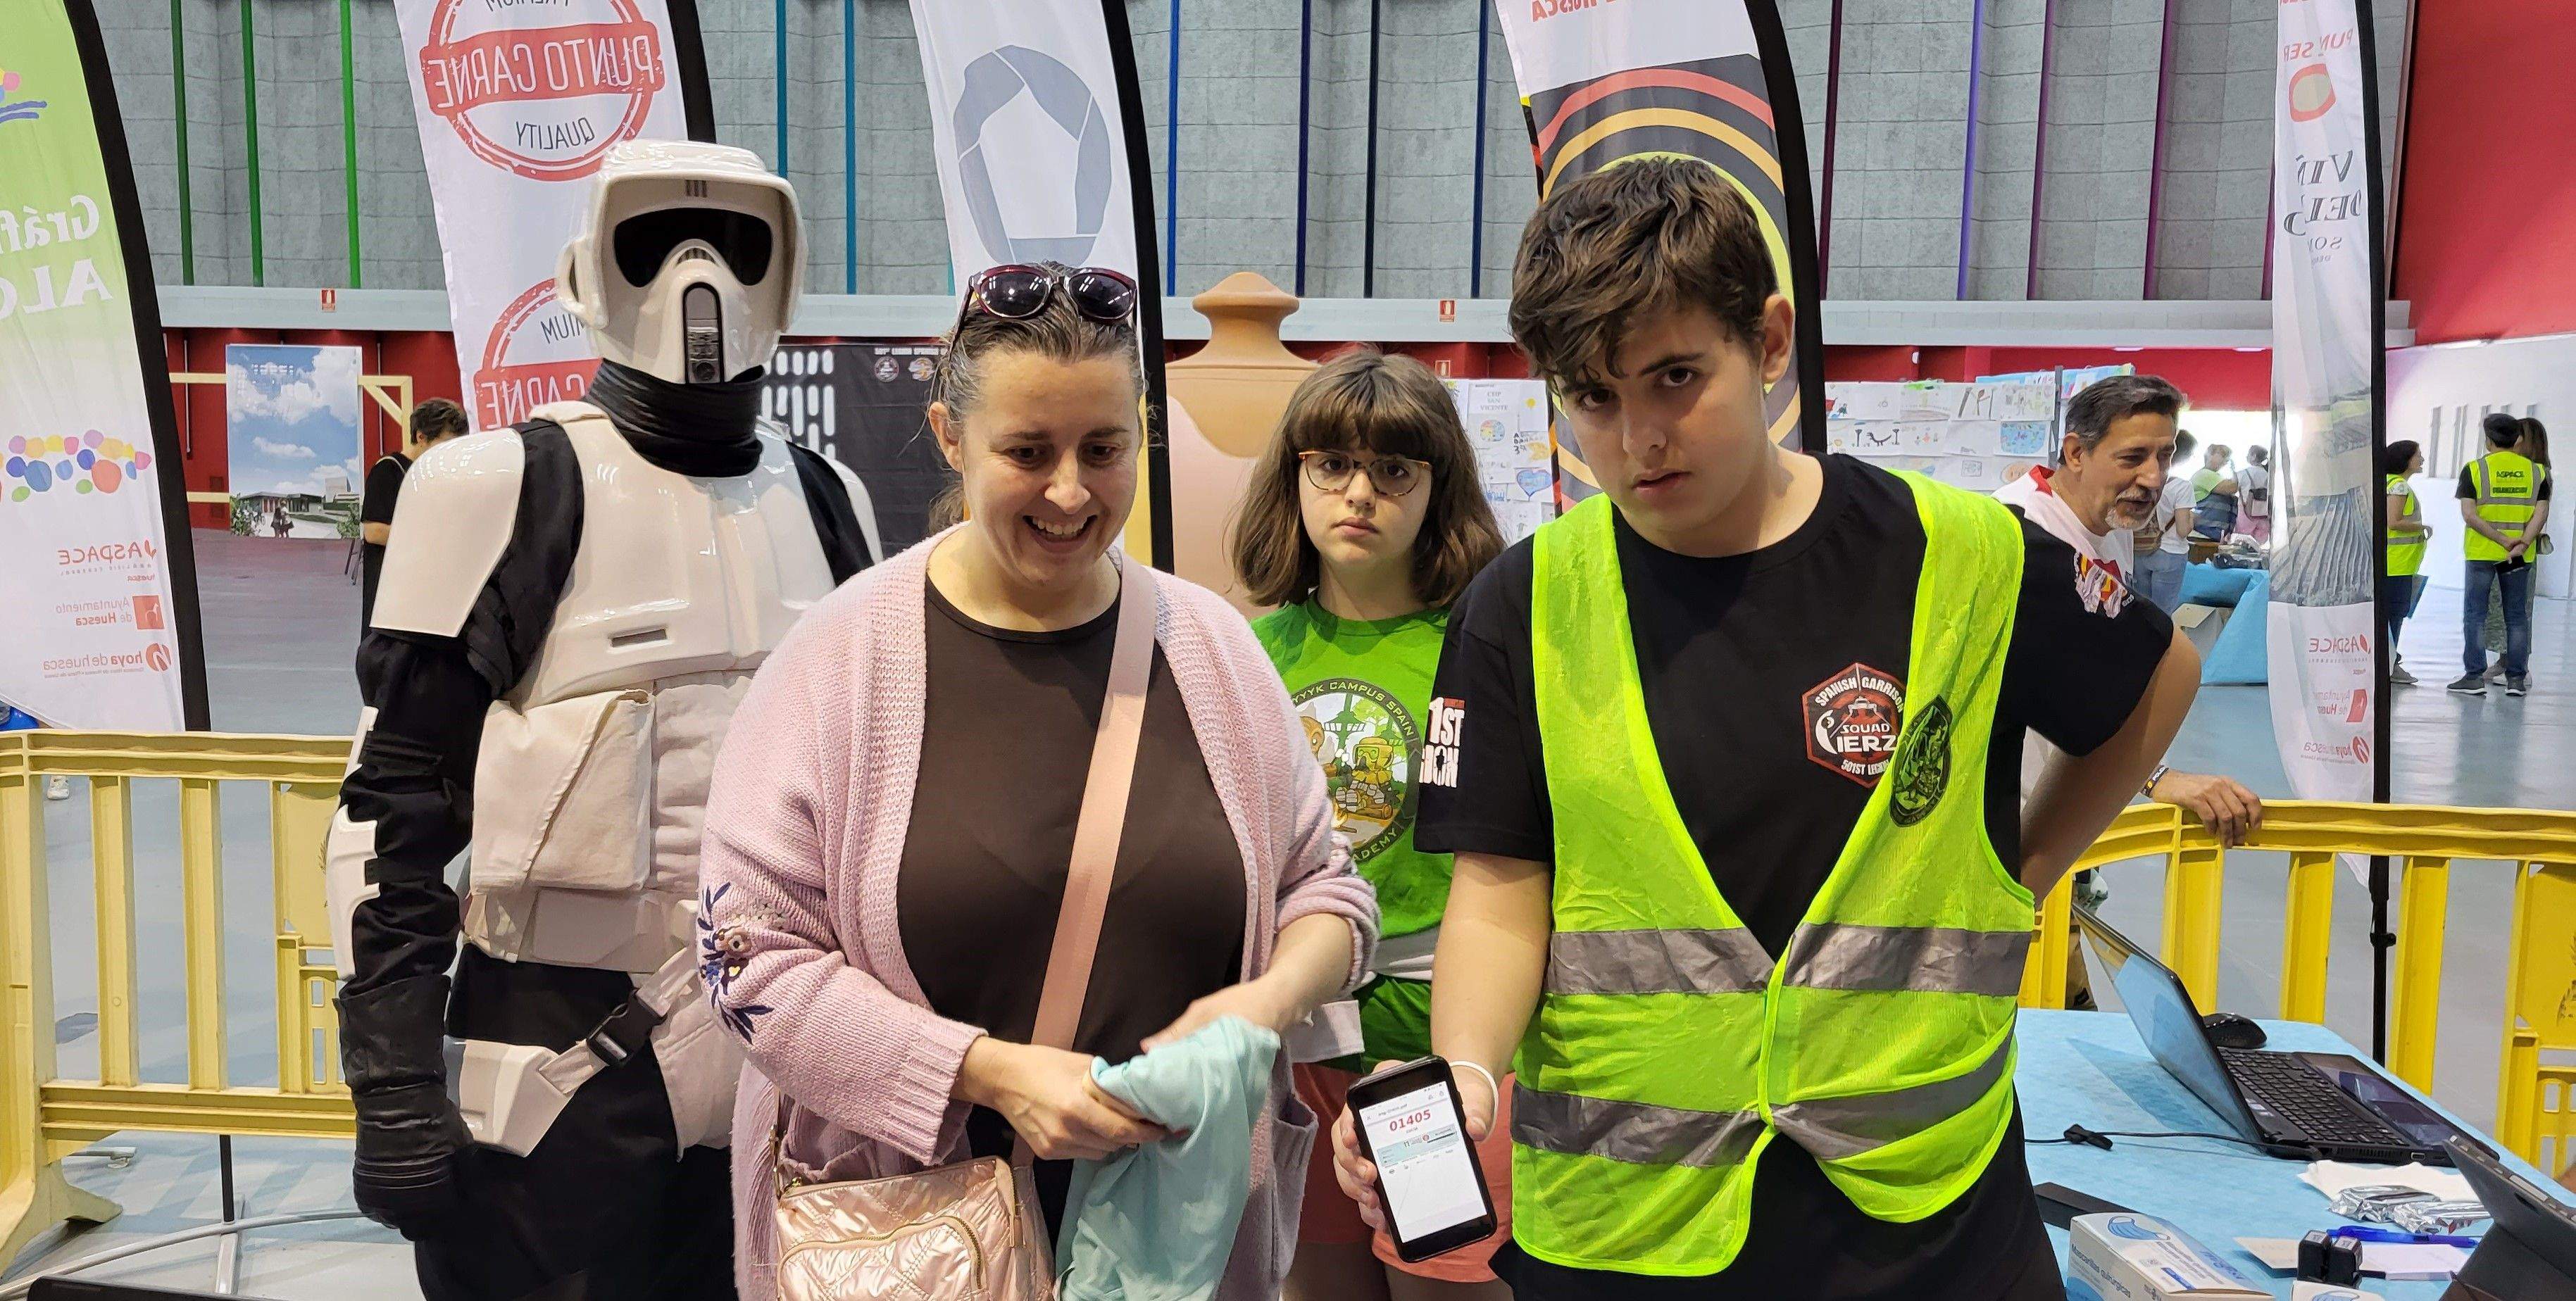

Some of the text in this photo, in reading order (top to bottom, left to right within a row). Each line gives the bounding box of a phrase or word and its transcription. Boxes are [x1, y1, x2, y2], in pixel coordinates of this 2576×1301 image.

[1330, 681, 1385, 701] CAMPUS
[1386, 700, 1414, 736] SPAIN
[1815, 677, 1904, 713] SPANISH GARRISON
[1842, 760, 1866, 775] 501ST
[1389, 1110, 1431, 1131] 01405
